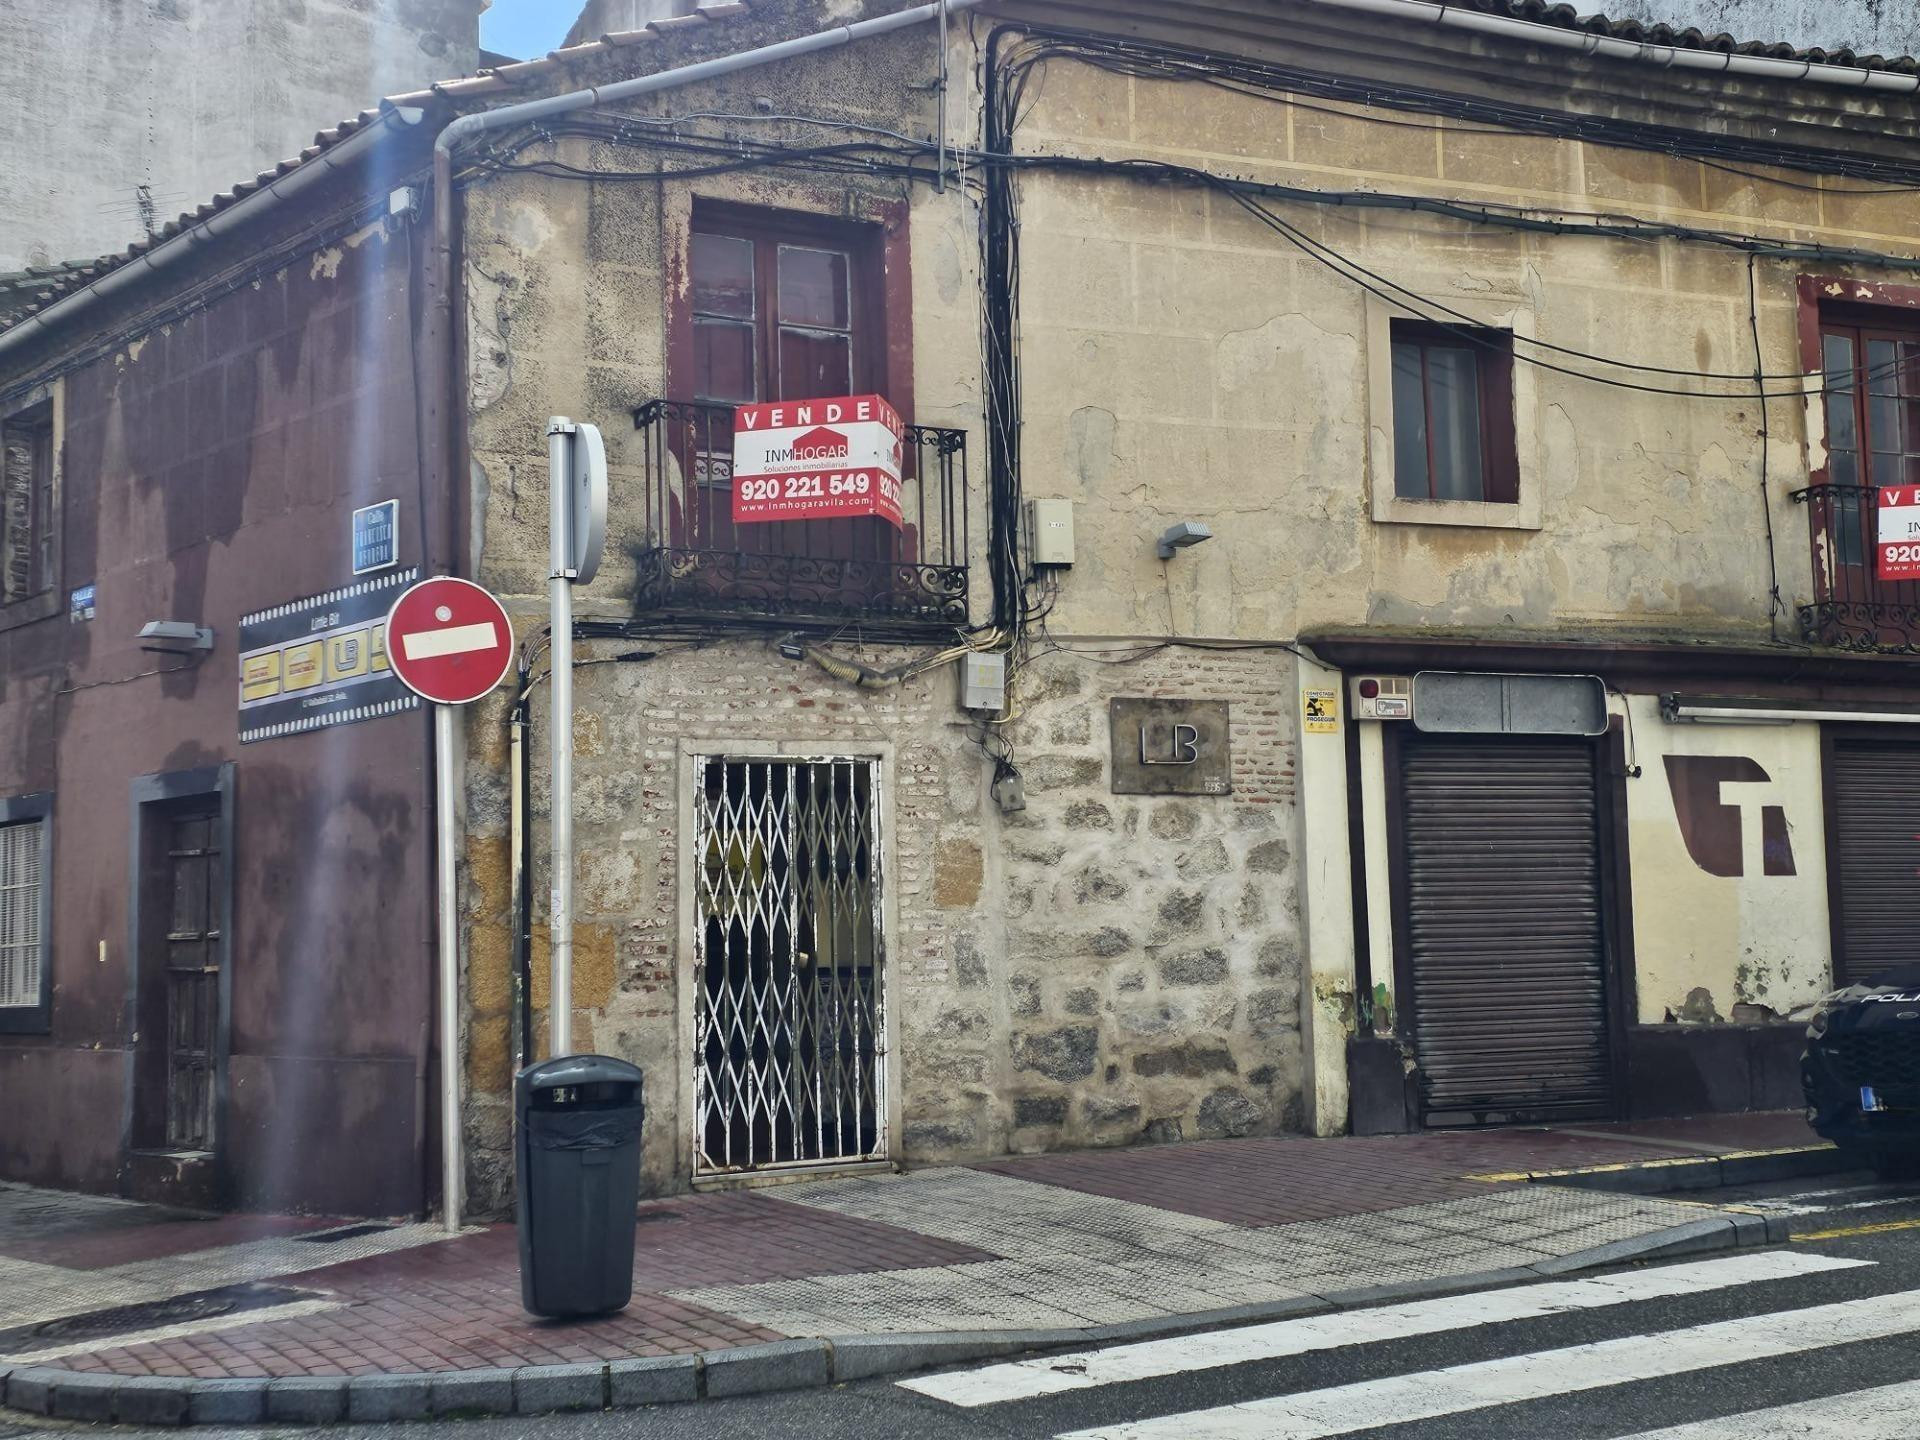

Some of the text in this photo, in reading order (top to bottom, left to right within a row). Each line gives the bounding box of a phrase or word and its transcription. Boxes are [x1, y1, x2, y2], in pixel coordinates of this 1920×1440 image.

[743, 401, 870, 429] VENDE
[764, 445, 848, 463] INMHOGAR
[763, 460, 848, 474] Soluciones inmobiliarias
[741, 472, 870, 501] 920 221 549
[1885, 545, 1920, 563] 920
[1142, 724, 1198, 764] LB
